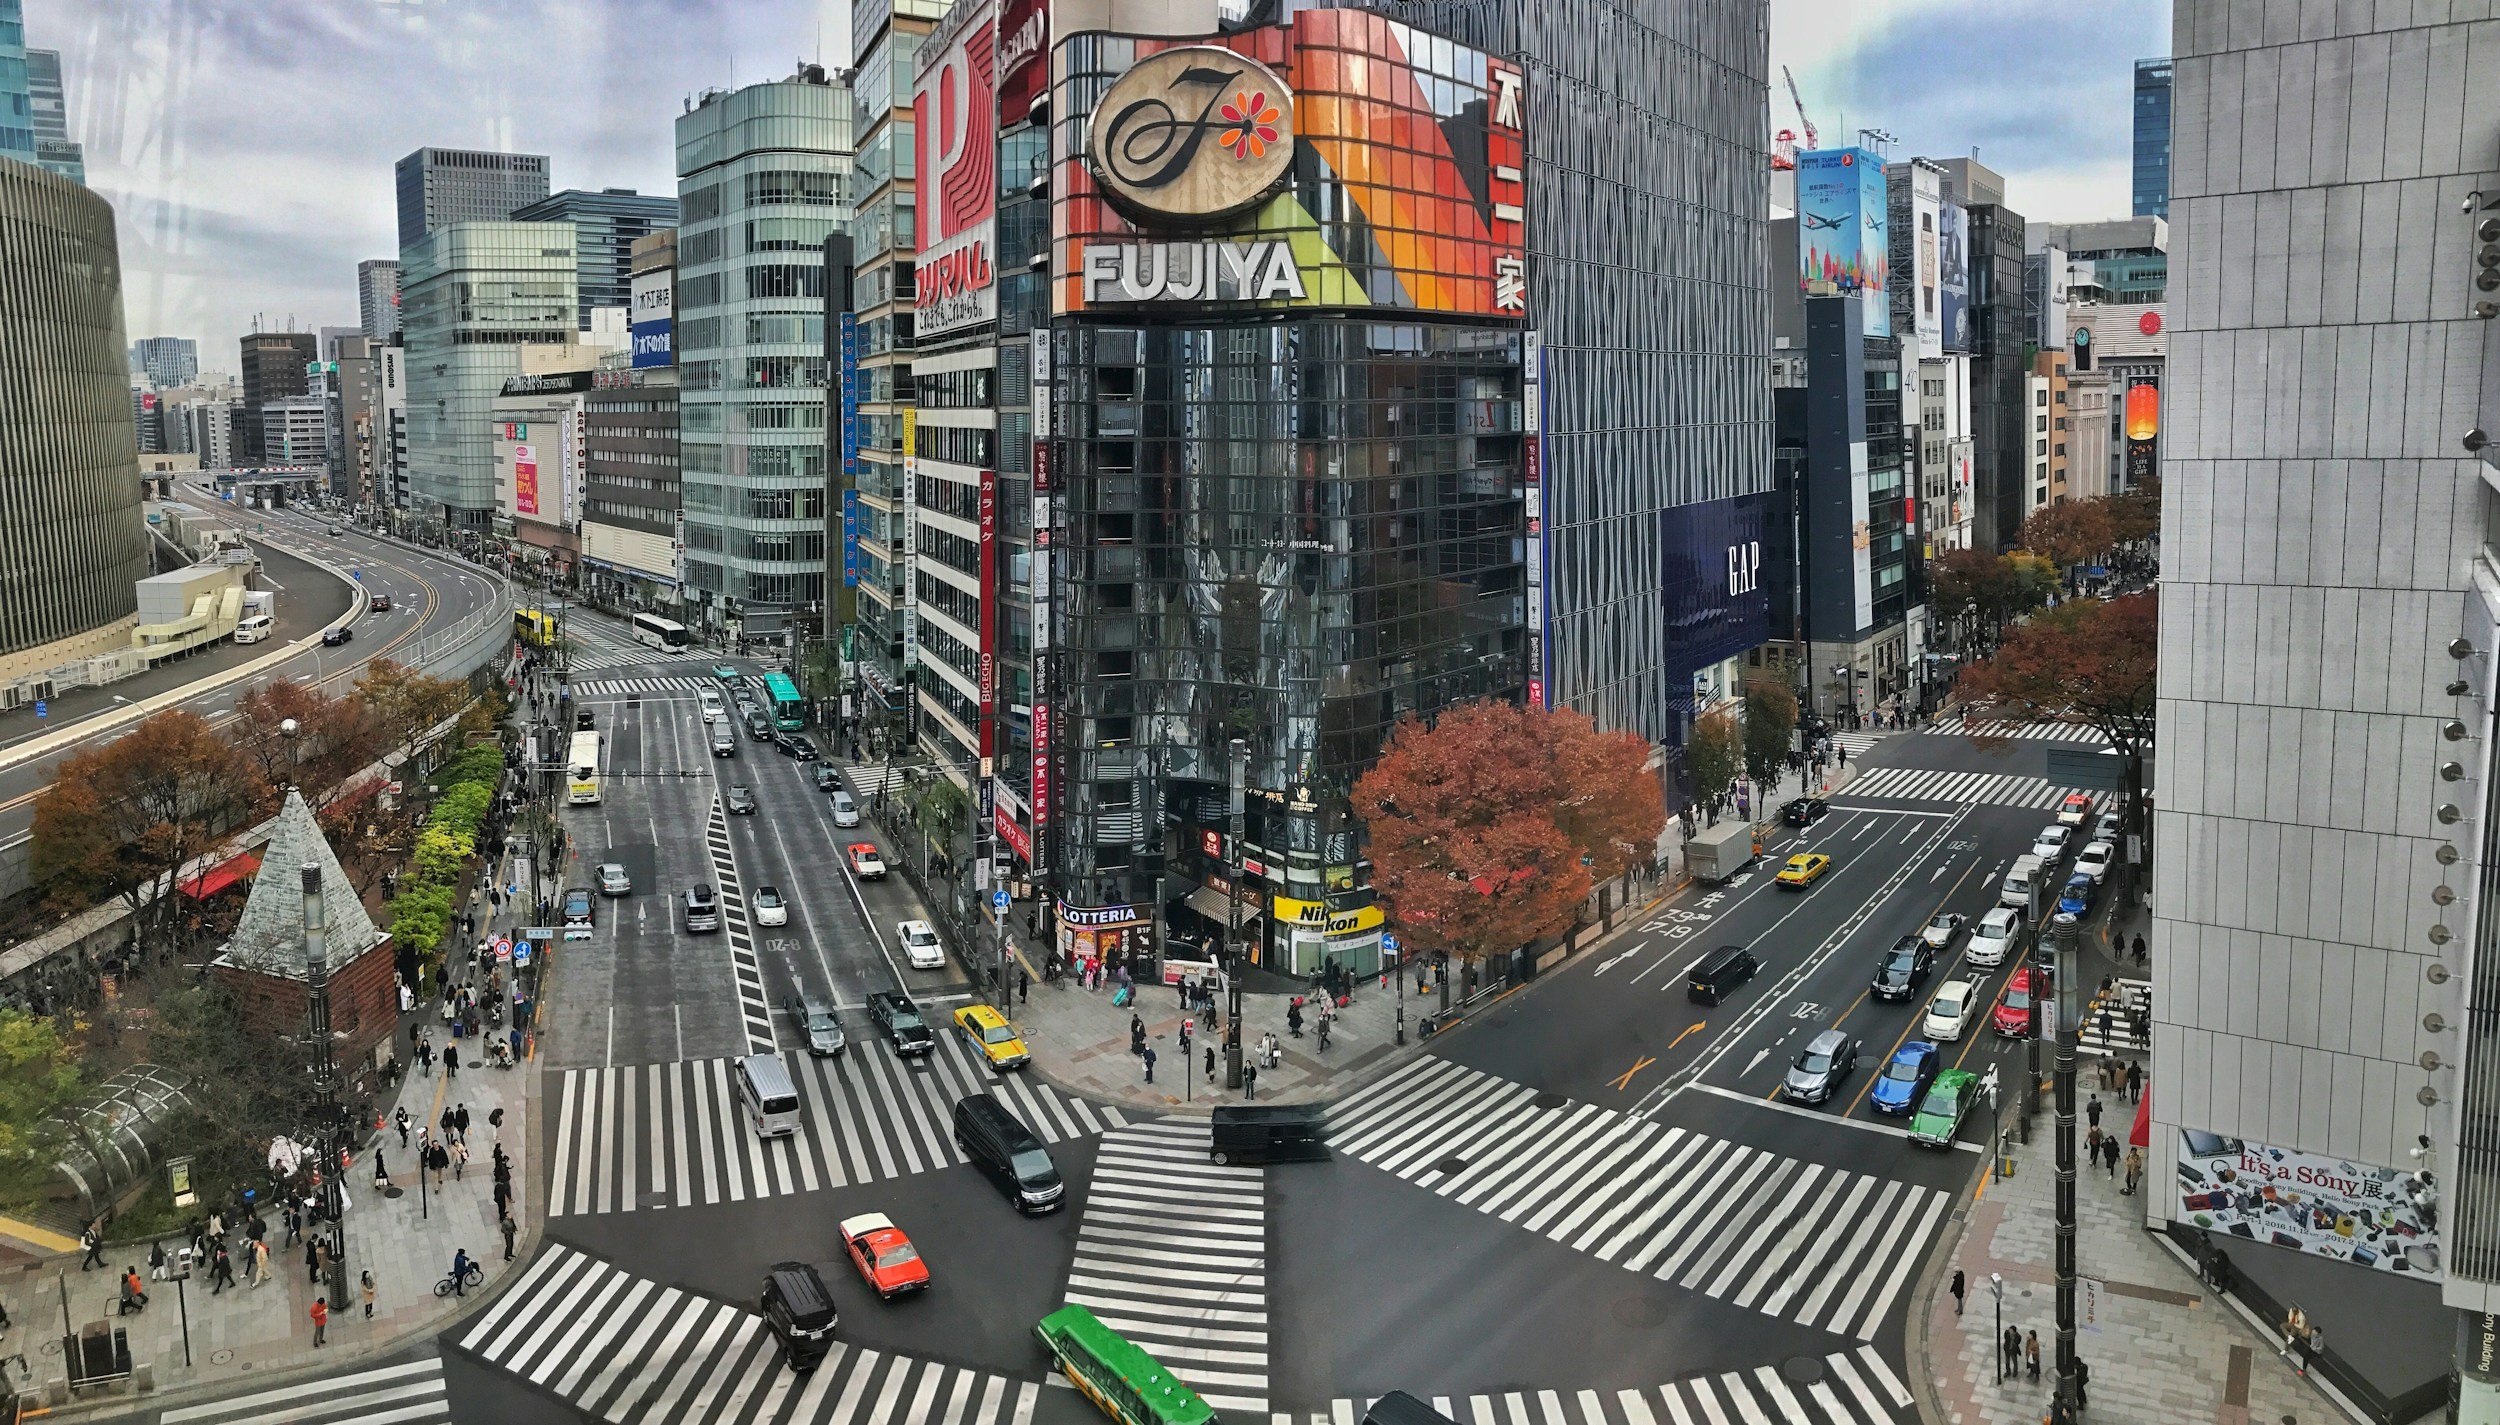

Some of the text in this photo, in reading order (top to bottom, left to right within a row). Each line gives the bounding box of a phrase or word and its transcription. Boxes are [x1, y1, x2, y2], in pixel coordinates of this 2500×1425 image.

[1494, 67, 1524, 310] 不二家
[2001, 224, 2024, 247] GUCCI
[1083, 238, 1306, 301] FUJIYA
[640, 288, 670, 310] 木下工務店
[640, 333, 671, 355] 木下の介護
[507, 374, 542, 392] PRINTEMPS
[981, 480, 993, 543] カラオケ
[755, 536, 791, 544] DIESEL
[1728, 541, 1760, 597] GAP
[981, 652, 992, 703] BIG ECHO
[1036, 655, 1046, 694] 星乃珈琲店
[1036, 768, 1046, 808] 不二家
[997, 814, 1016, 840] カラオケ
[1063, 908, 1137, 924] LOTTERIA
[1657, 908, 1714, 923] 7-9:30
[1637, 920, 1693, 939] 17-19
[765, 938, 802, 952] 8-20
[1789, 1001, 1833, 1021] 8-20
[2238, 1153, 2271, 1176] It's
[2277, 1166, 2292, 1180] a
[2237, 1175, 2271, 1187] Goodbye
[2272, 1183, 2286, 1193] Sony
[2321, 1193, 2341, 1202] Hello
[2342, 1198, 2360, 1208] Sony
[2236, 1213, 2262, 1225] Part-1
[2264, 1220, 2309, 1236] 2016.11.12
[2325, 1233, 2367, 1248] 2017.2.12
[2478, 1312, 2496, 1372] ony Building
